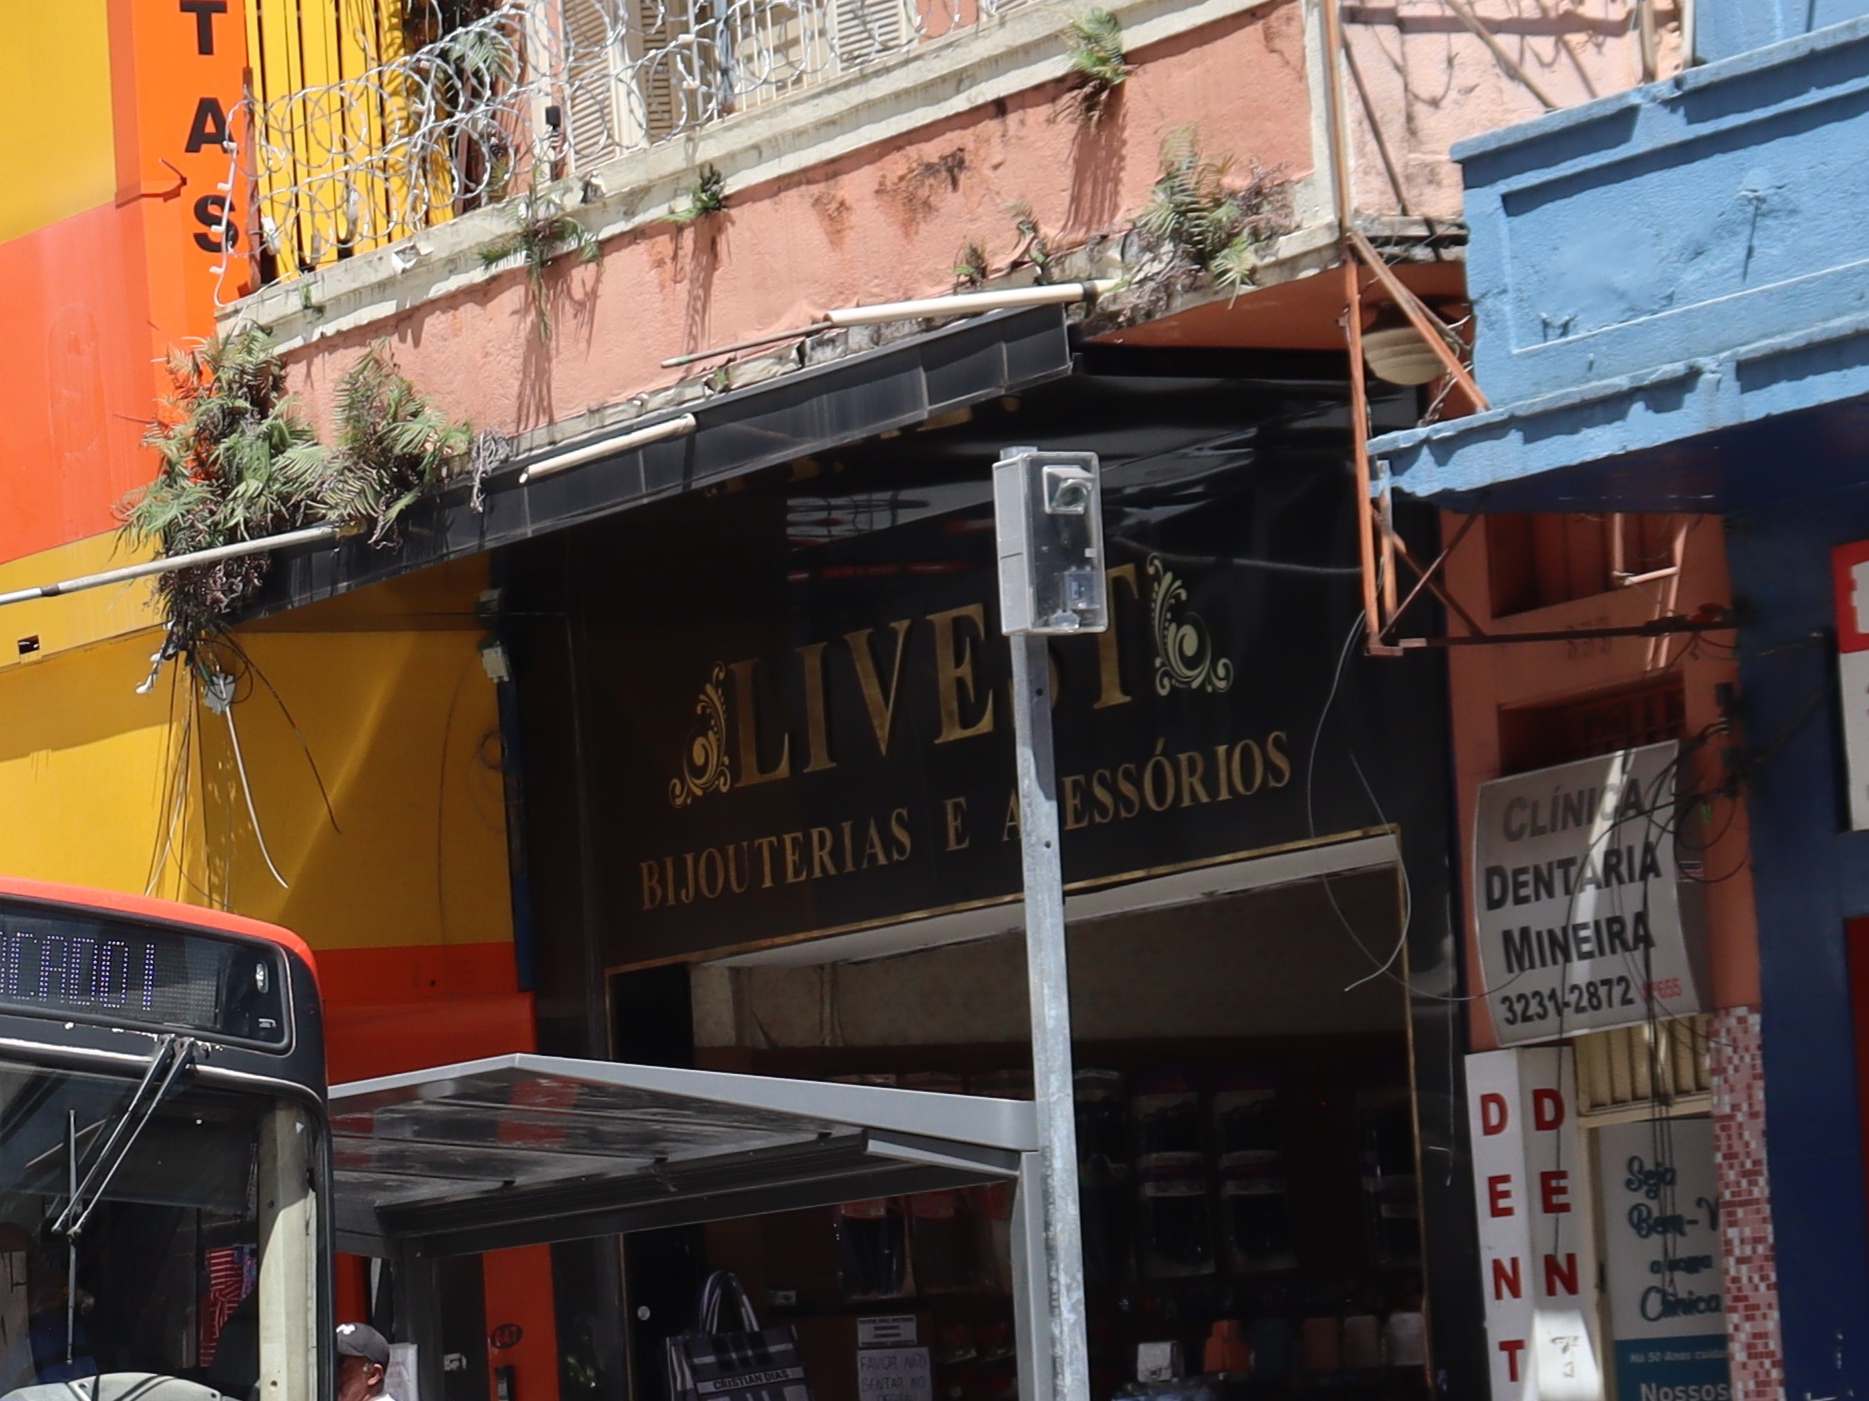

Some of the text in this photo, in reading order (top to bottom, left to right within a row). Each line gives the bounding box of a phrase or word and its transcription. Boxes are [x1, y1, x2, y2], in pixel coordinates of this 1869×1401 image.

[729, 563, 1138, 788] LIVET
[639, 730, 1293, 912] BIJOUTERIAS E AESSÓRIOS
[1501, 975, 1635, 1025] 3231-2872
[1502, 911, 1656, 974] MINEIRA
